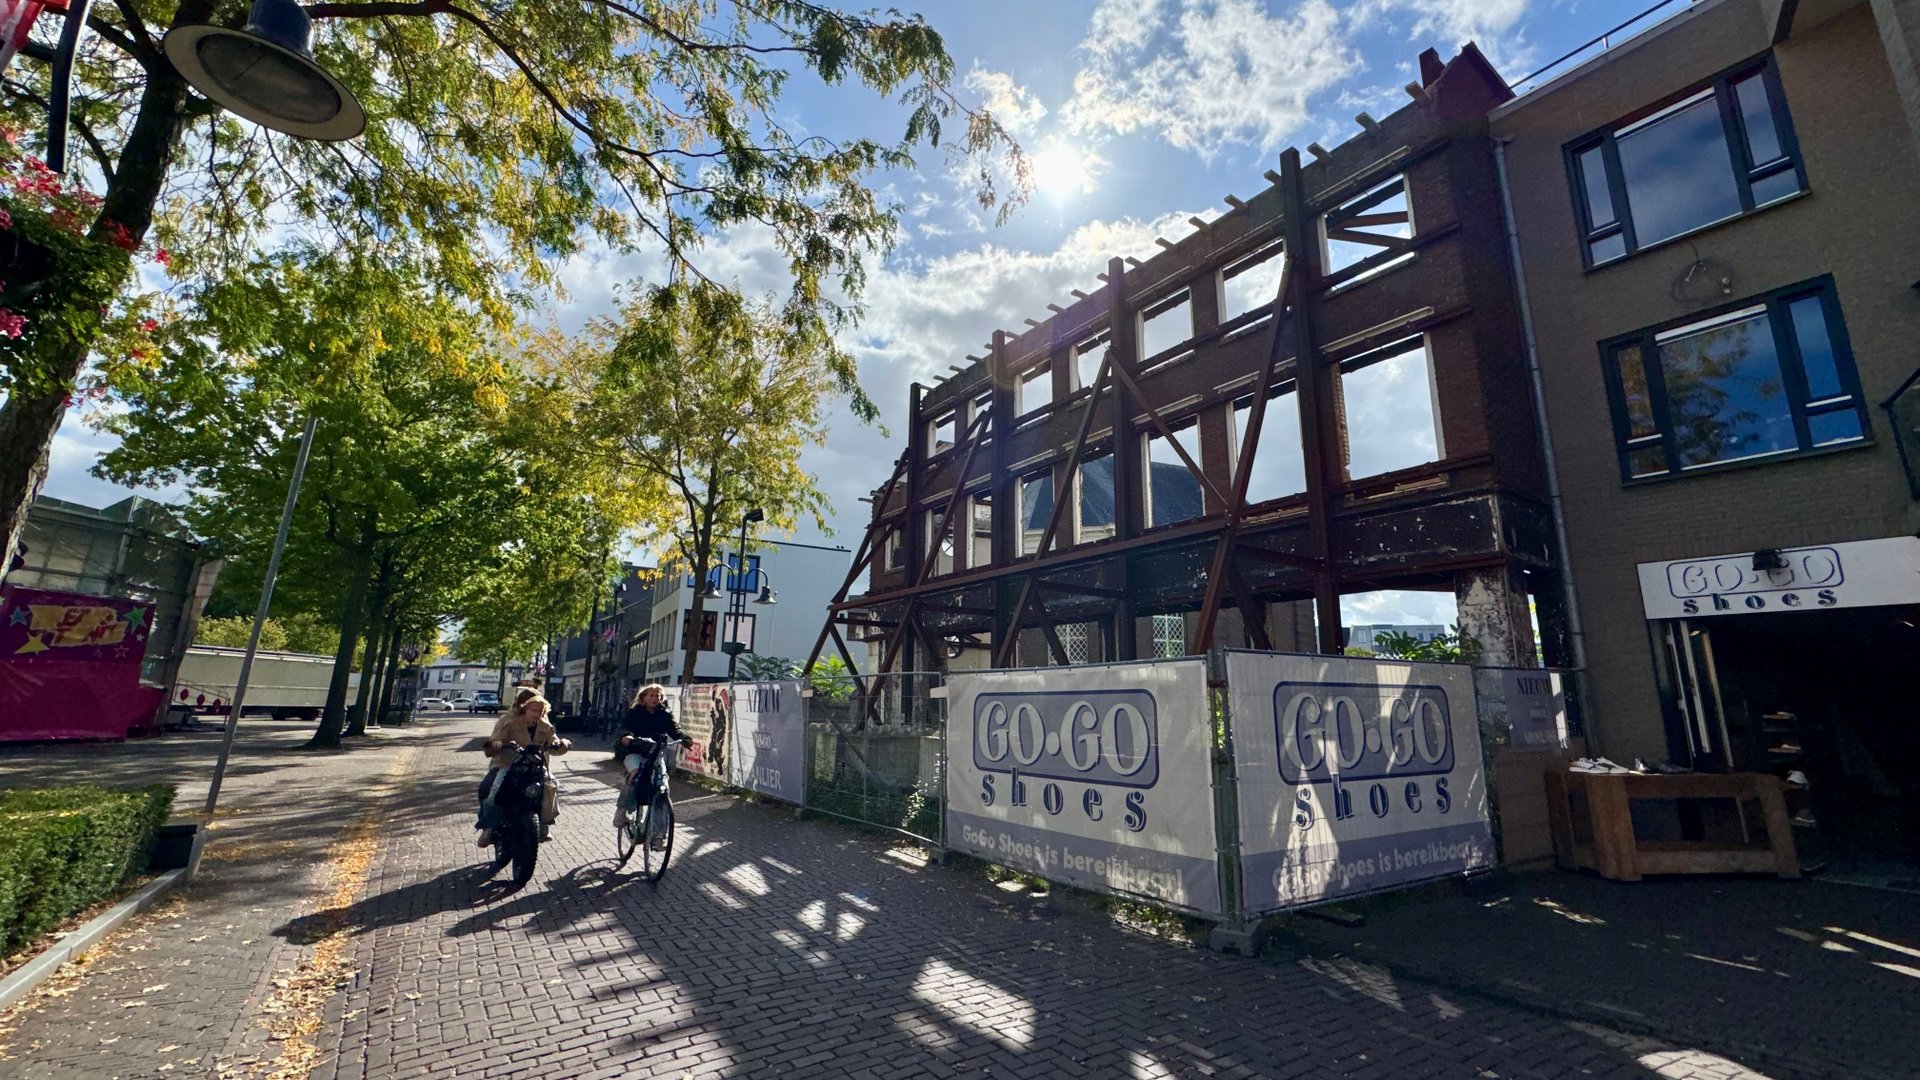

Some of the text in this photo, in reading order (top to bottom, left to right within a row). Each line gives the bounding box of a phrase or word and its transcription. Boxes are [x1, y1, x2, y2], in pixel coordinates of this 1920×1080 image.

[1682, 589, 1837, 615] shoes
[746, 687, 783, 714] NIEUW
[980, 766, 1148, 833] shoes
[1295, 773, 1452, 832] shoes
[962, 824, 995, 849] GoGo
[999, 833, 1042, 861] Shoes
[1045, 846, 1059, 865] is
[1378, 851, 1392, 873] is
